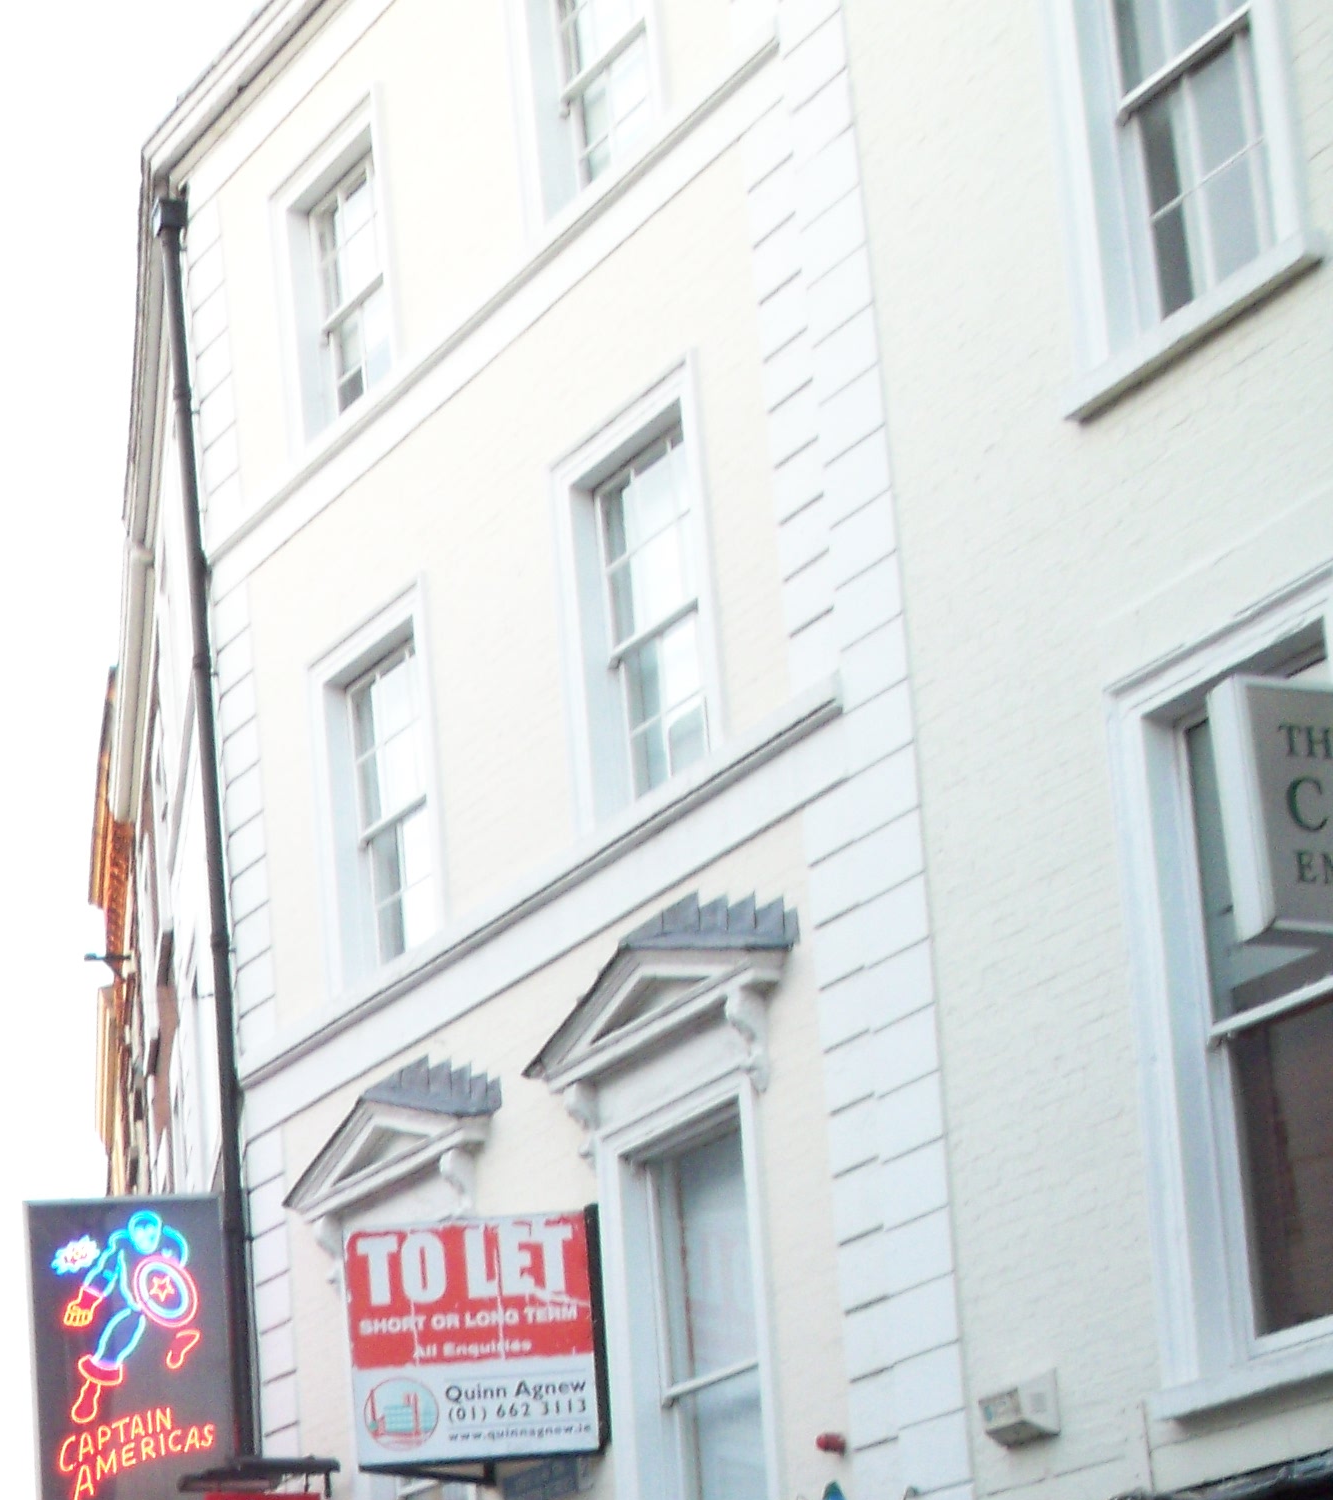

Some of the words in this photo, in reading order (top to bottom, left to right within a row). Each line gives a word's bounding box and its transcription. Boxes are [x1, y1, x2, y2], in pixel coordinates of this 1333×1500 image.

[356, 1232, 446, 1306] TO
[464, 1219, 573, 1300] LET
[360, 1315, 426, 1336] SHORT
[433, 1312, 459, 1330] OR
[465, 1308, 519, 1326] LONG
[525, 1303, 578, 1324] TERM
[414, 1342, 437, 1359] All
[443, 1338, 532, 1359] Enquiries
[445, 1384, 507, 1401] Quinn
[515, 1379, 587, 1401] Agnew
[448, 1406, 487, 1425] (01)
[496, 1402, 531, 1419] 662
[541, 1398, 587, 1416] 3113
[58, 1406, 173, 1473] CAPTAIN
